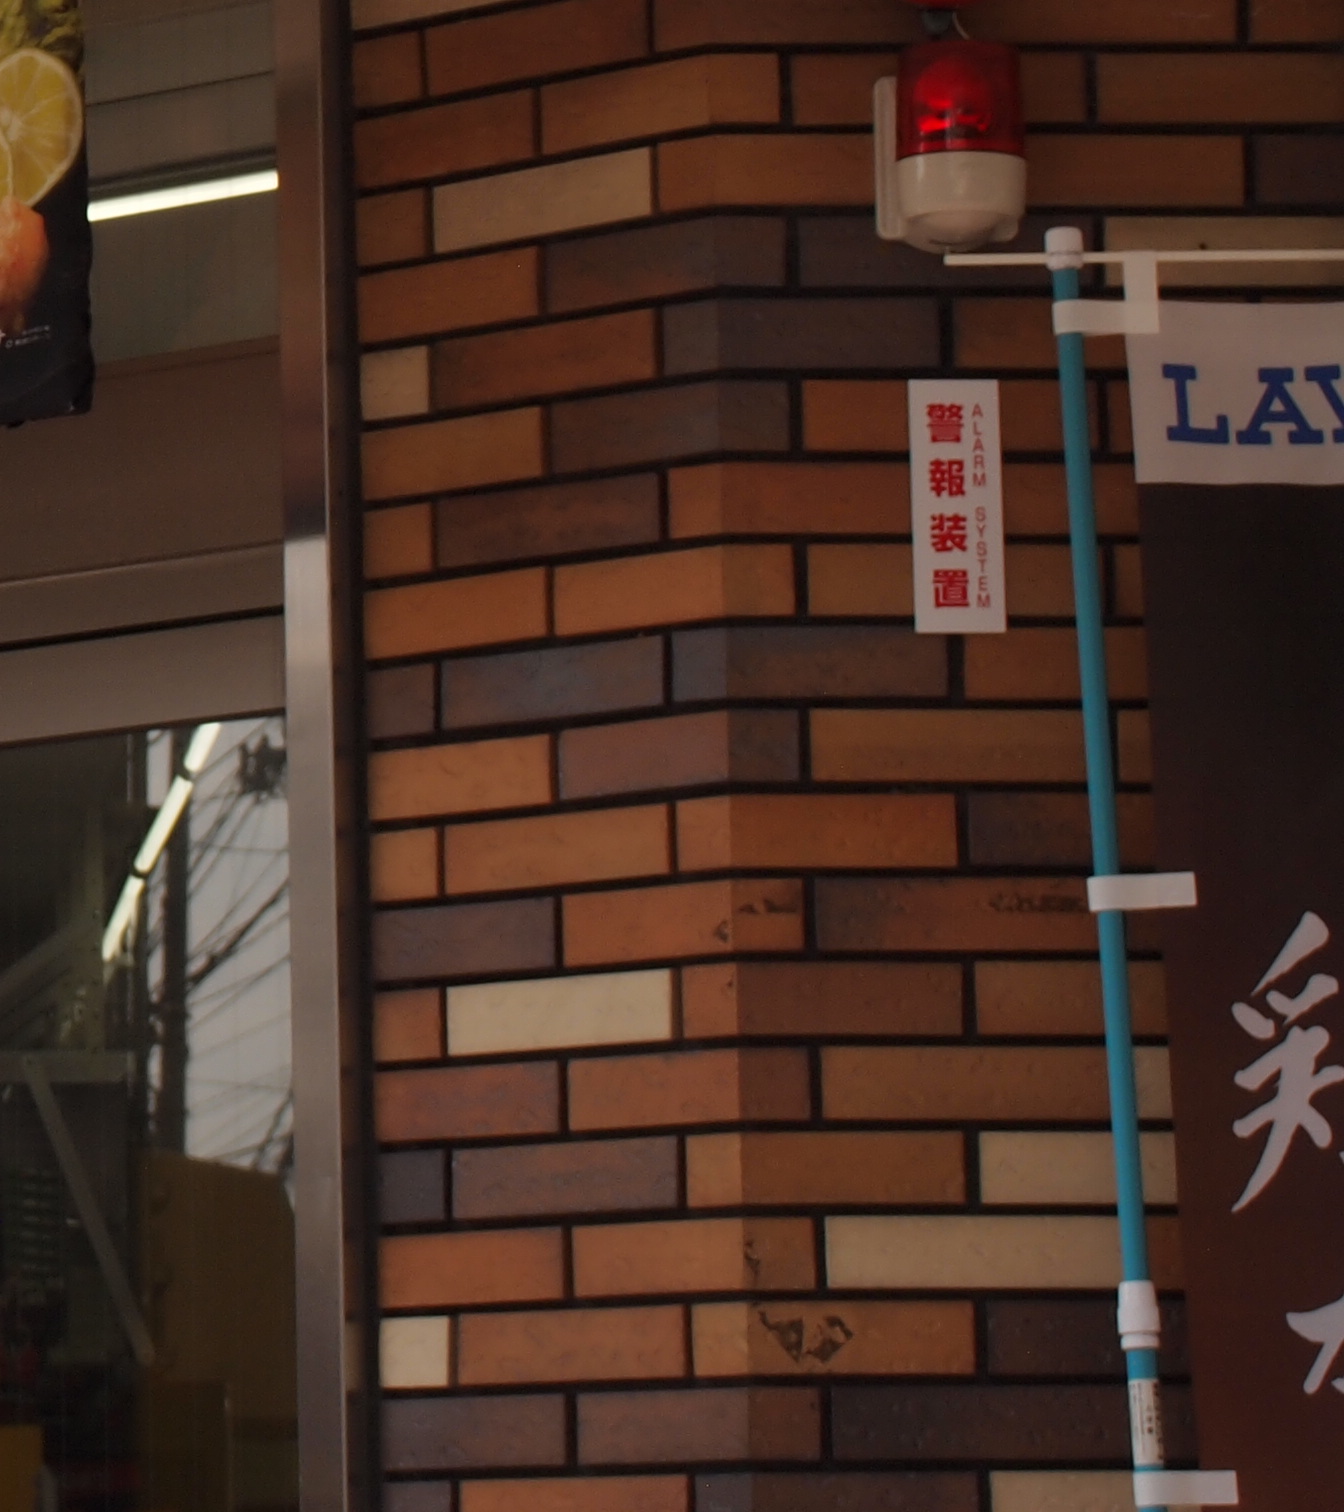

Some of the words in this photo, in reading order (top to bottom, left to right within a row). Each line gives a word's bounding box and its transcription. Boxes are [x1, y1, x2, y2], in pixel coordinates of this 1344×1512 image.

[971, 403, 987, 487] ALARM
[926, 403, 970, 609] 警報装置
[974, 506, 991, 609] SYSTEM
